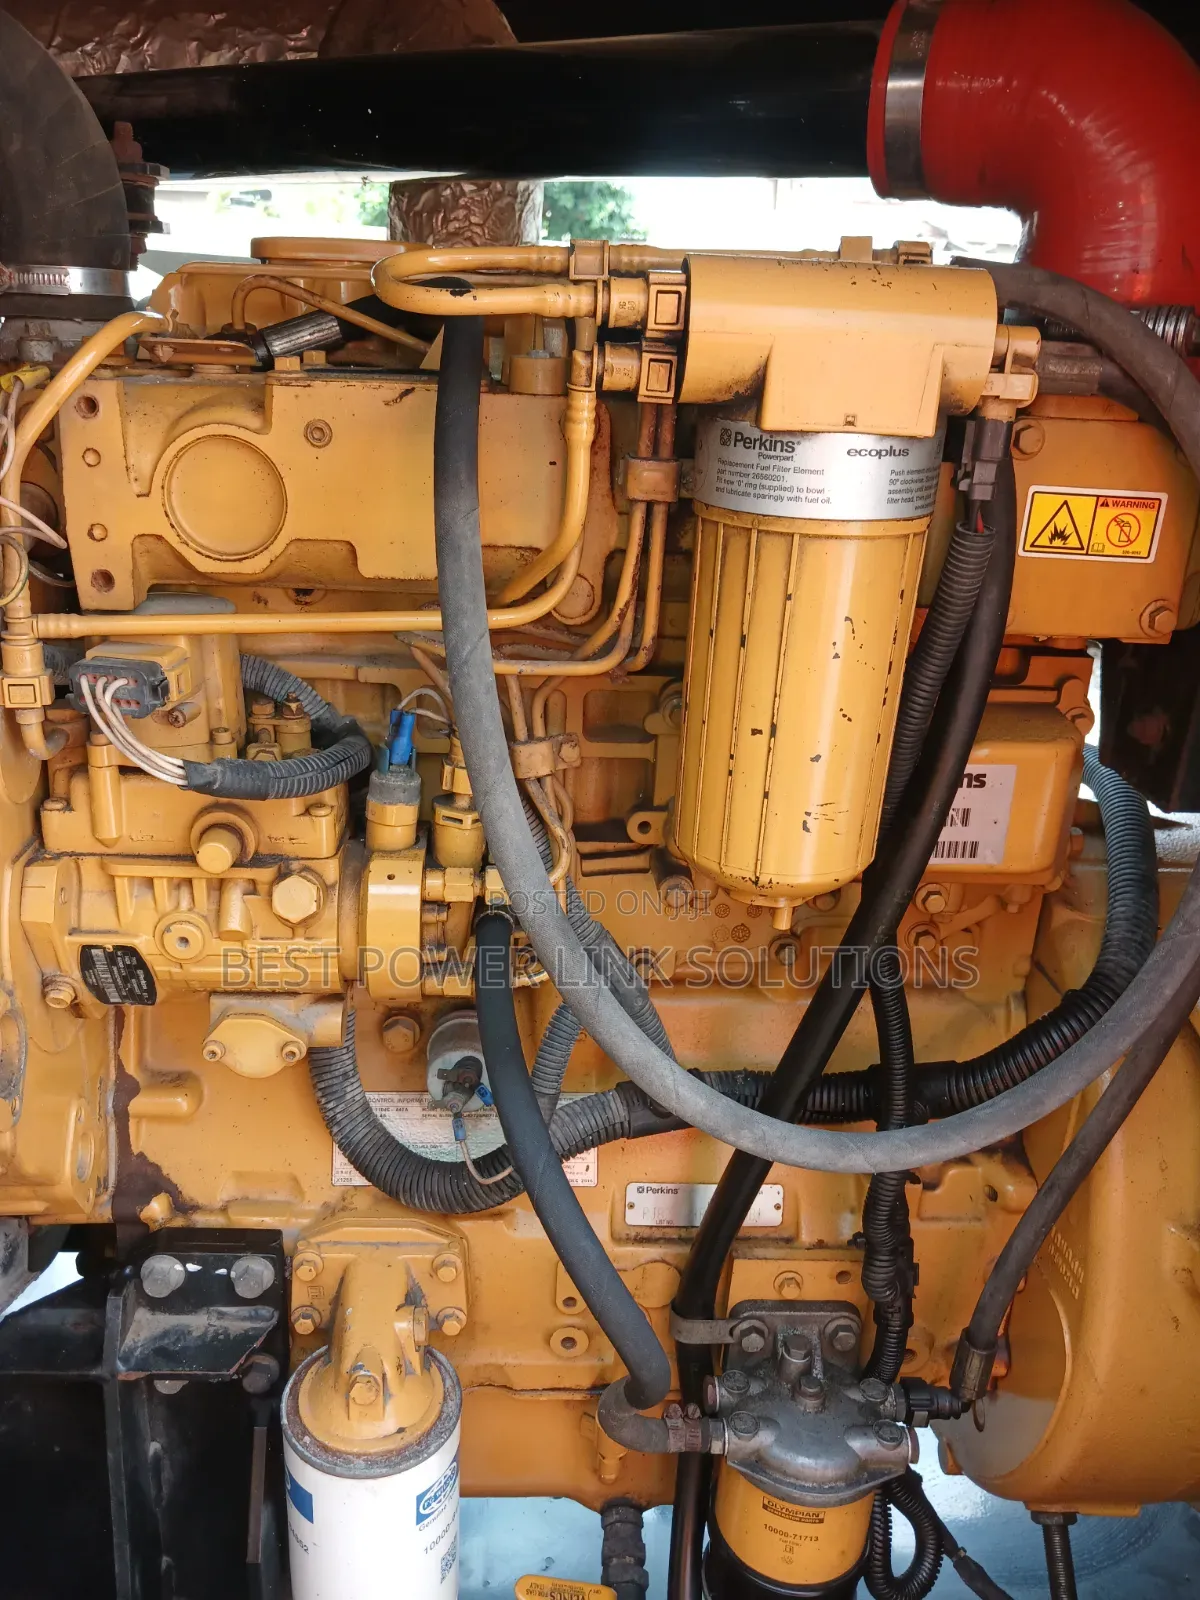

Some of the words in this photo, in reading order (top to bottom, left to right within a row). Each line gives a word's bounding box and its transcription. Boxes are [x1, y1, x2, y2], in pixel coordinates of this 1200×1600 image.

[734, 431, 795, 453] Perkins
[757, 452, 794, 463] Powerpart
[847, 445, 910, 460] ecoplus
[717, 468, 726, 476] part
[728, 470, 750, 479] number
[718, 458, 754, 469] Replacement
[756, 464, 770, 472] Fuel
[772, 465, 791, 473] Filter
[793, 467, 824, 476] Element
[744, 481, 757, 490] ring
[759, 481, 794, 494] (supplied)
[805, 486, 825, 494] bowl
[726, 487, 751, 498] lubricate
[753, 492, 785, 503] sparingly
[786, 495, 803, 503] with
[804, 496, 819, 504] fuel
[1111, 499, 1155, 509] WARNING
[646, 1186, 679, 1195] Perkins
[767, 1500, 820, 1518] OLYMPIAN
[763, 1523, 819, 1542] 10000-71713
